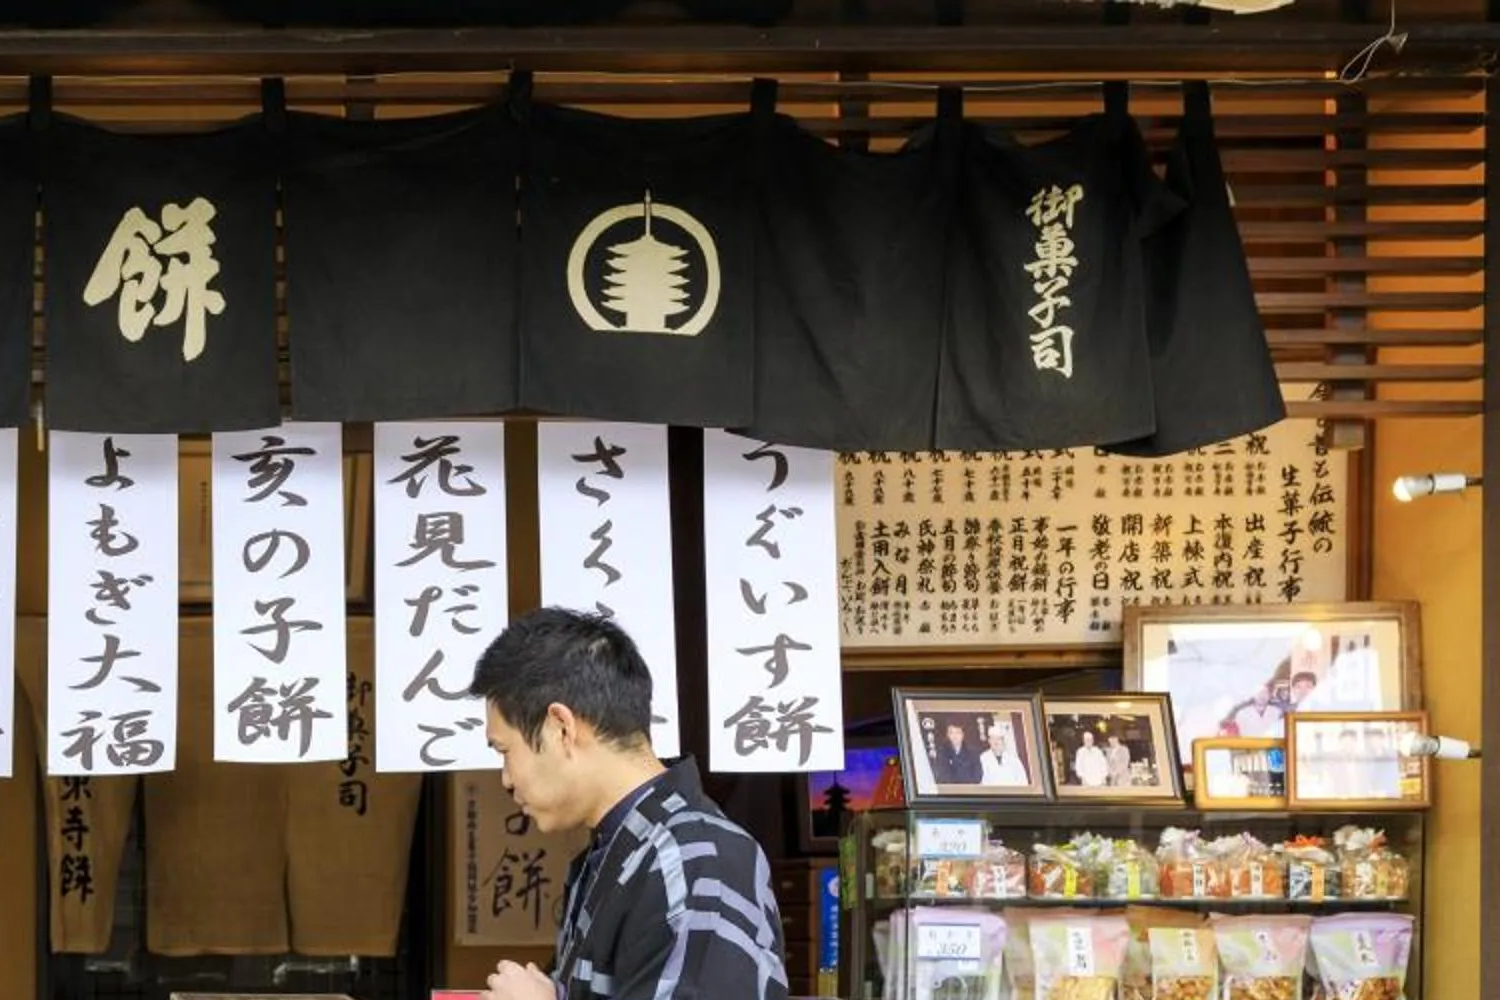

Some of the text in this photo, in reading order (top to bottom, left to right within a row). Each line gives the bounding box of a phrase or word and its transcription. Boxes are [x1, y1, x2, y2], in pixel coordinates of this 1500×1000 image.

[1024, 184, 1084, 379] 御菓子司
[1054, 524, 1078, 624] 一年の行事
[1091, 512, 1112, 592] 敬老の日
[1119, 513, 1144, 592] 開店祝
[1151, 513, 1174, 590] 新築祝
[1182, 514, 1205, 590] 上棟式
[1243, 513, 1268, 588] 出産祝
[1277, 464, 1304, 603] 生菓子行事
[60, 437, 165, 771] よもぎ大福
[227, 436, 334, 758] 亥の子餅
[387, 436, 497, 767] 花見だんご
[723, 445, 835, 766] うぐいす餅
